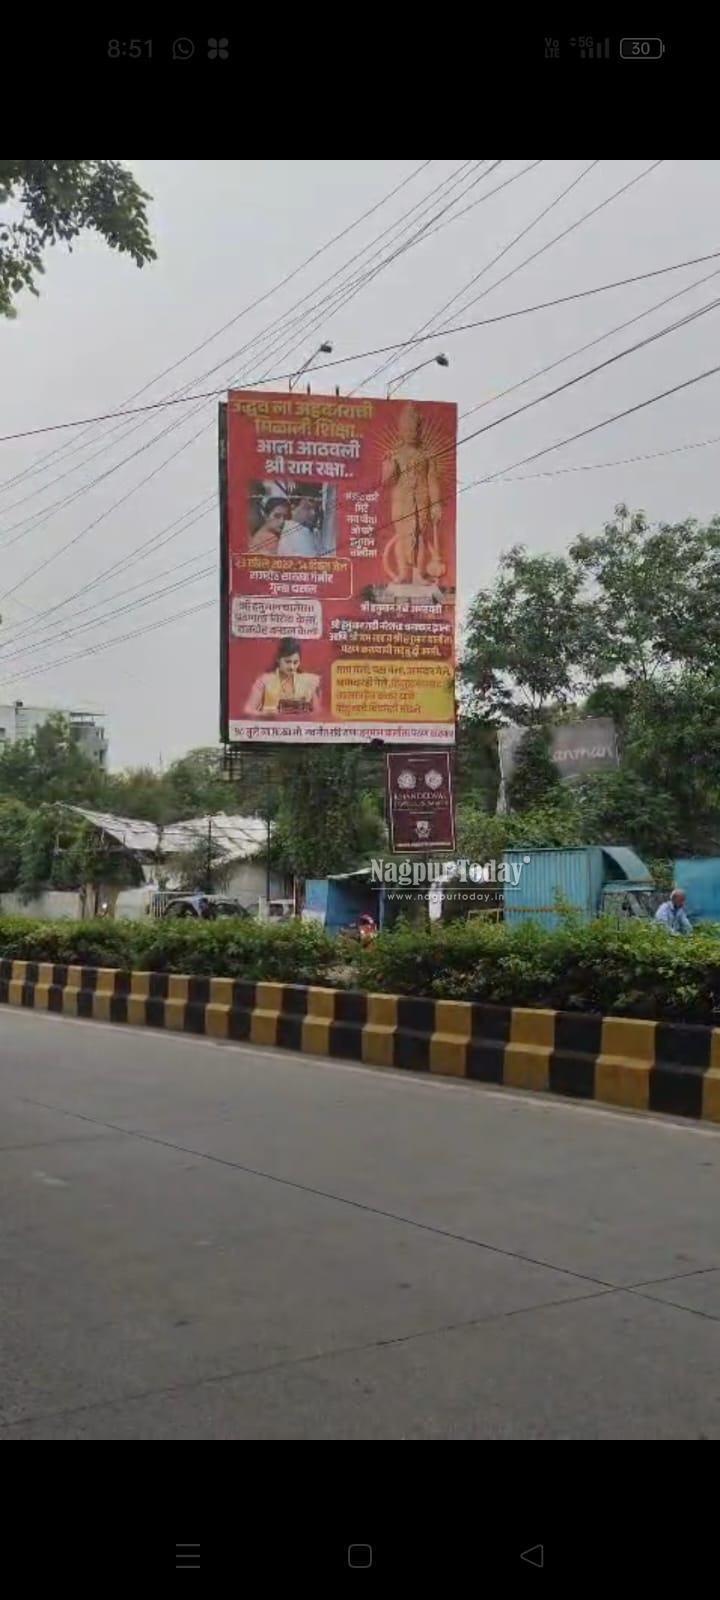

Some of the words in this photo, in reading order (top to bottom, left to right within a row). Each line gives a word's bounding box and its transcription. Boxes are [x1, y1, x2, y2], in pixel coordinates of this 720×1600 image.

[254, 418, 312, 436] मिळाली
[257, 439, 294, 455] आता
[296, 440, 361, 459] आठवली
[265, 456, 283, 474] श्री
[288, 459, 313, 476] राम
